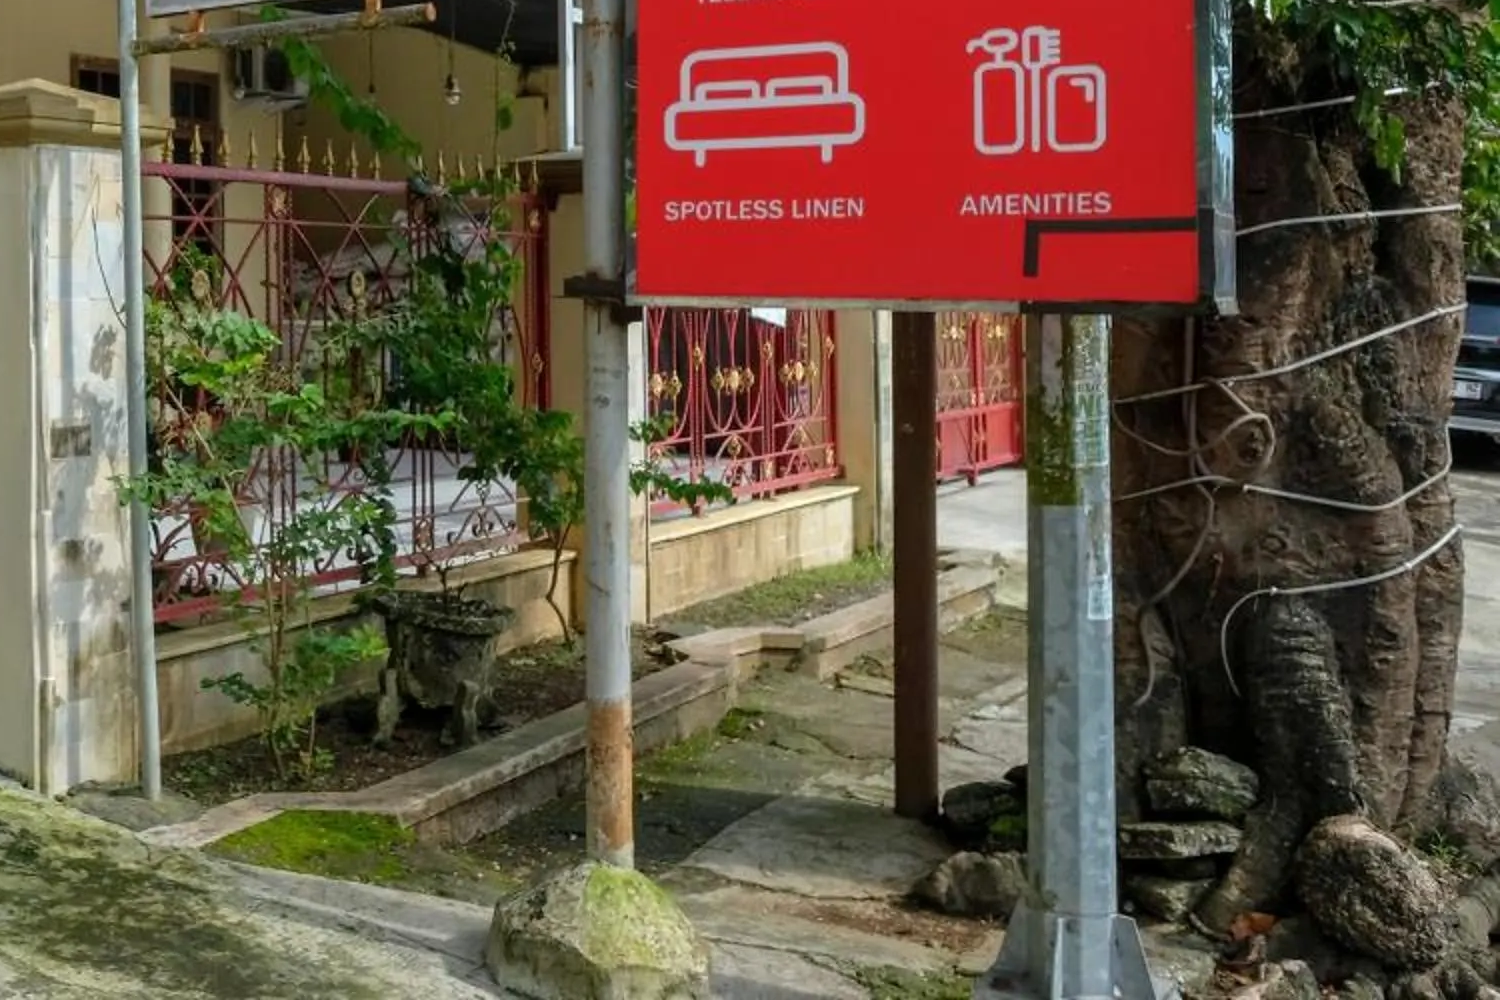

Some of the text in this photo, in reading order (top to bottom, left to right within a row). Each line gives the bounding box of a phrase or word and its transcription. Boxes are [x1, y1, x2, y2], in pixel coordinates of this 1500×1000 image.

[664, 197, 865, 222] SPOTLESS LINEN
[959, 190, 1113, 216] AMENITIES
